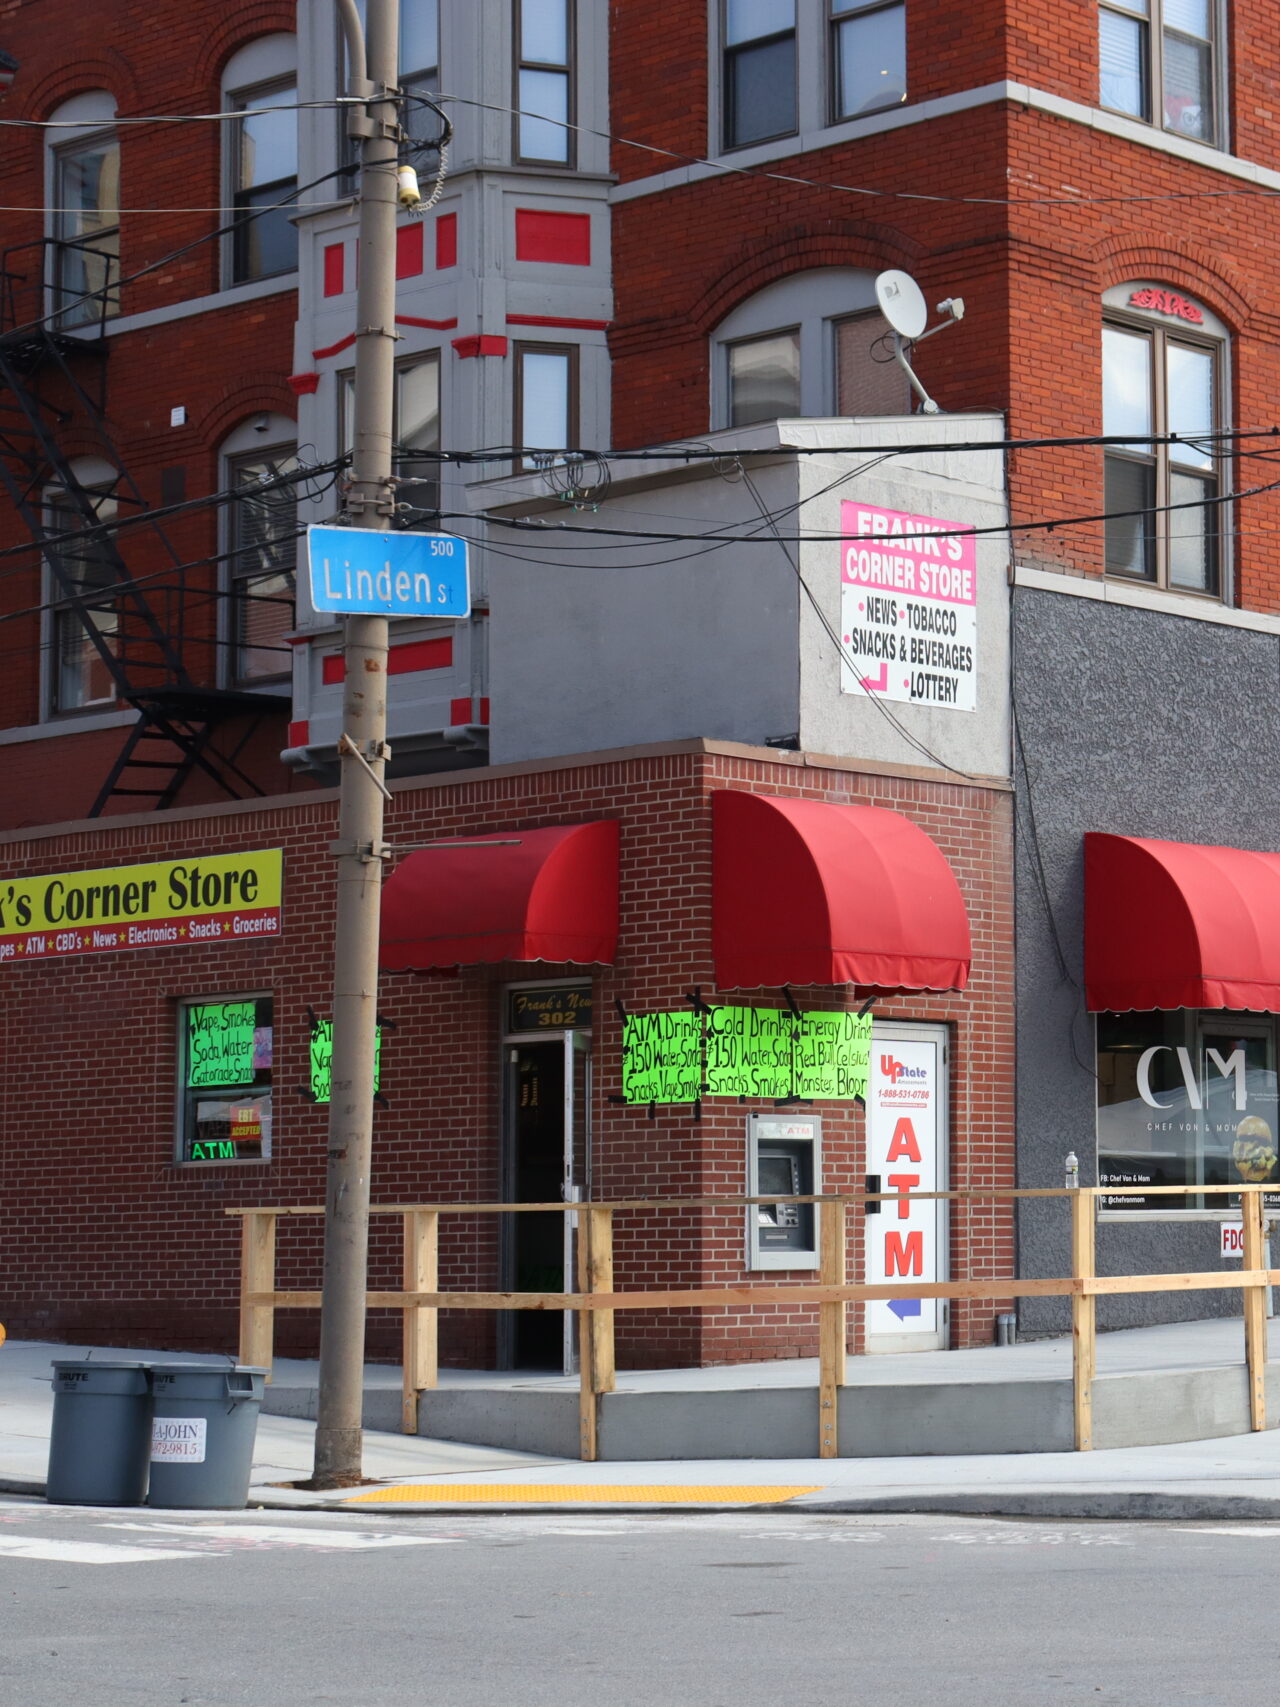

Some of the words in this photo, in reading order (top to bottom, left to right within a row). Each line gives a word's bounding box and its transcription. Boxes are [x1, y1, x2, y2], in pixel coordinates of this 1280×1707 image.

[431, 540, 454, 557] 500
[857, 511, 963, 561] FRANK'S
[324, 558, 432, 603] Linden
[846, 547, 915, 590] CORNER
[919, 561, 972, 600] STORE
[867, 596, 897, 627] NEWS
[906, 603, 957, 637] TOBACCO
[852, 627, 896, 660] SNACKS
[900, 635, 907, 662] &
[910, 637, 972, 673] BEVERAGES
[910, 671, 959, 703] LOTTERY
[44, 879, 157, 923] Corner
[168, 866, 259, 911] Store
[26, 935, 45, 954] ATM
[56, 931, 82, 951] CBD's
[93, 930, 117, 948] News
[128, 922, 177, 945] Electronics
[189, 919, 221, 938] Snacks
[233, 913, 277, 933] Groceries
[517, 994, 562, 1013] Frank's
[538, 1011, 577, 1026] 302
[314, 1020, 333, 1043] AT
[711, 1006, 744, 1036] Cold
[750, 1007, 792, 1037] Drinks
[801, 1011, 840, 1045] Energy
[222, 1030, 252, 1058] Water
[795, 1039, 816, 1067] Red
[1136, 1046, 1247, 1111] CVM
[231, 1125, 262, 1136] ACCEPTED
[787, 1127, 810, 1135] ATM
[1147, 1123, 1172, 1131] CHEF
[1180, 1123, 1198, 1131] VON
[1216, 1123, 1237, 1132] MOM
[191, 1141, 234, 1159] ATM
